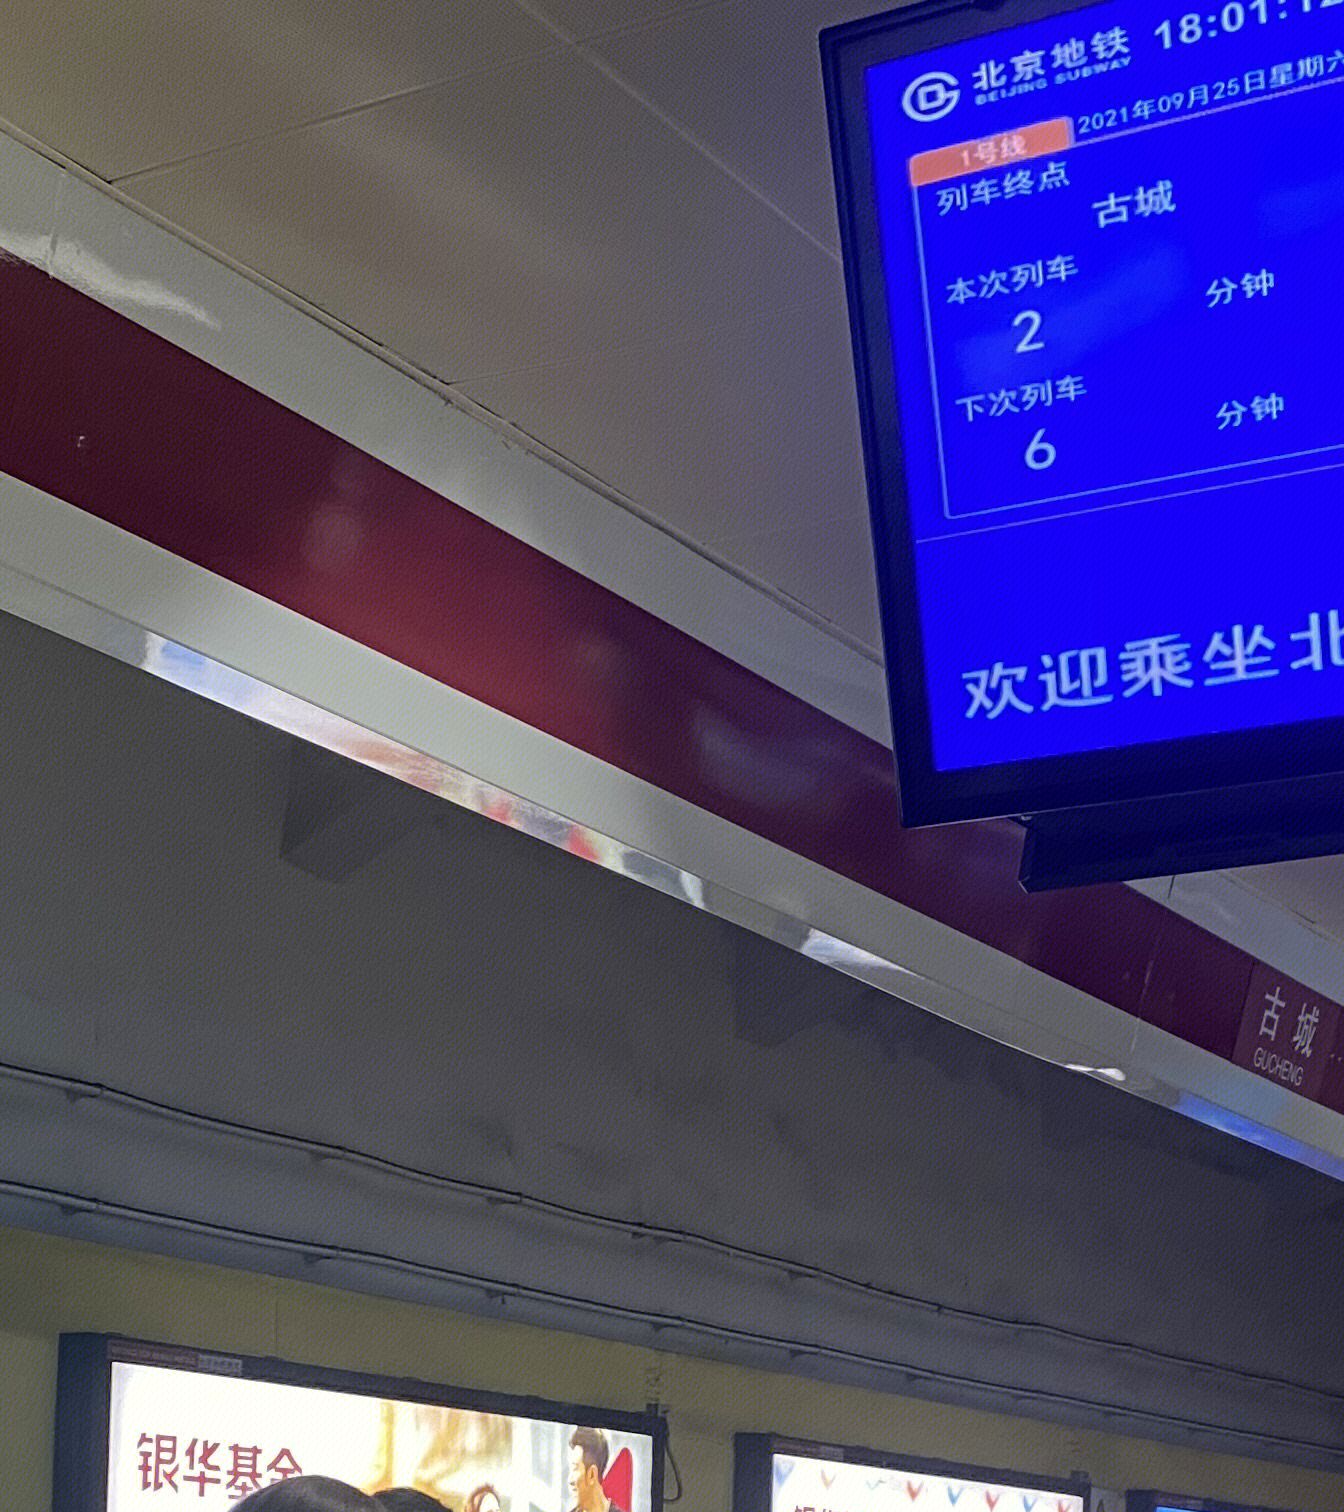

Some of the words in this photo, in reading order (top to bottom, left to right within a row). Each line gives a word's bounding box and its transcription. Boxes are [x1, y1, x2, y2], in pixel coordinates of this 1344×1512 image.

[1154, 0, 1344, 49] 18:01:
[972, 26, 1130, 91] 北京地铁
[975, 78, 1048, 106] BEIJING
[1055, 55, 1131, 85] SUBWAY
[961, 134, 1028, 168] 1号线
[937, 161, 1071, 216] 列车终点
[1092, 180, 1177, 229] 古城
[945, 253, 1080, 306] 本次列车
[1206, 268, 1275, 308] 分钟
[1013, 310, 1046, 355] 2
[957, 375, 1088, 424] 下次列车
[1216, 391, 1285, 431] 分钟
[1024, 427, 1057, 471] 6
[1259, 986, 1321, 1058] 古城
[1253, 1046, 1305, 1086] GUCHENG
